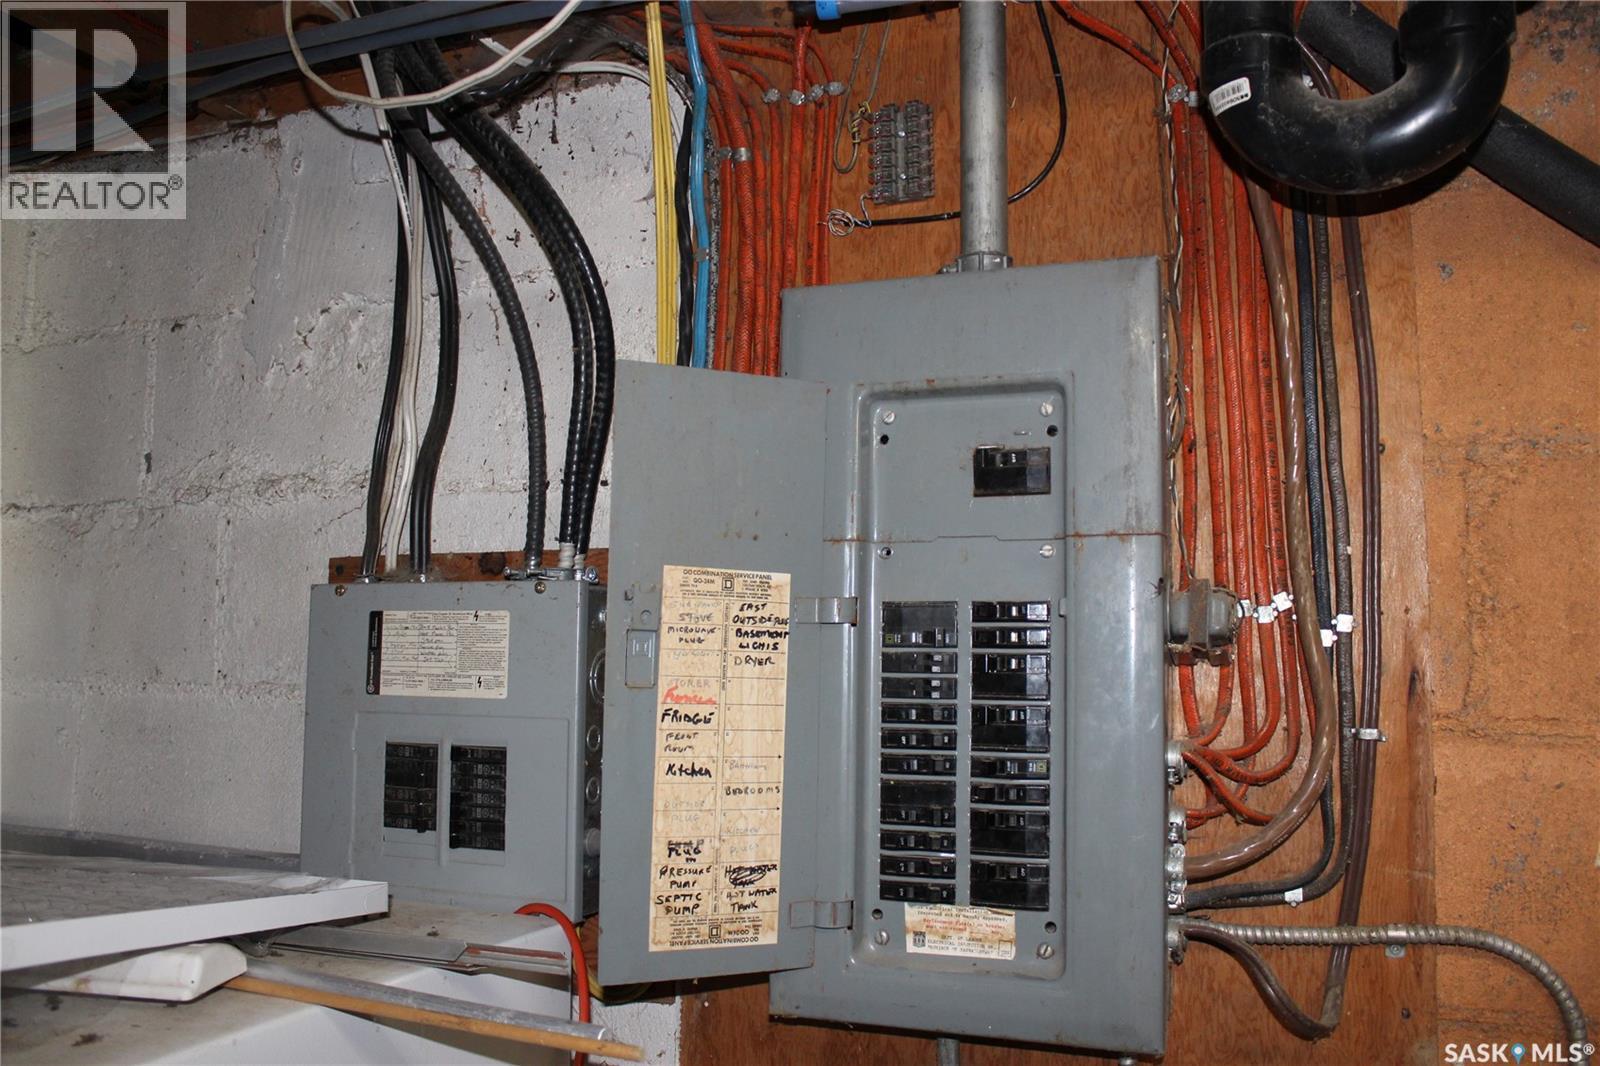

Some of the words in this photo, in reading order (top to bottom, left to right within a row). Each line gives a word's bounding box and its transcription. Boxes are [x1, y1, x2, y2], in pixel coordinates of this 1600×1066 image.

[692, 569, 734, 579] COMBINATION
[734, 572, 756, 580] SERVICE
[756, 573, 773, 581] PANEL
[739, 602, 768, 612] EAST
[732, 613, 773, 625] OUTSIDE
[667, 626, 717, 635] MICROWAVE
[735, 627, 790, 640] BASEMENT
[734, 654, 776, 668] DRYER
[661, 707, 715, 725] FRIDGE
[665, 762, 712, 778] Kitchen
[659, 865, 713, 879] PRESSURE
[669, 880, 697, 889] PUMP
[655, 892, 702, 905] SEPTIC
[665, 903, 700, 915] PUMP
[731, 900, 758, 916] TANK
[710, 937, 749, 945] COMBINATION
